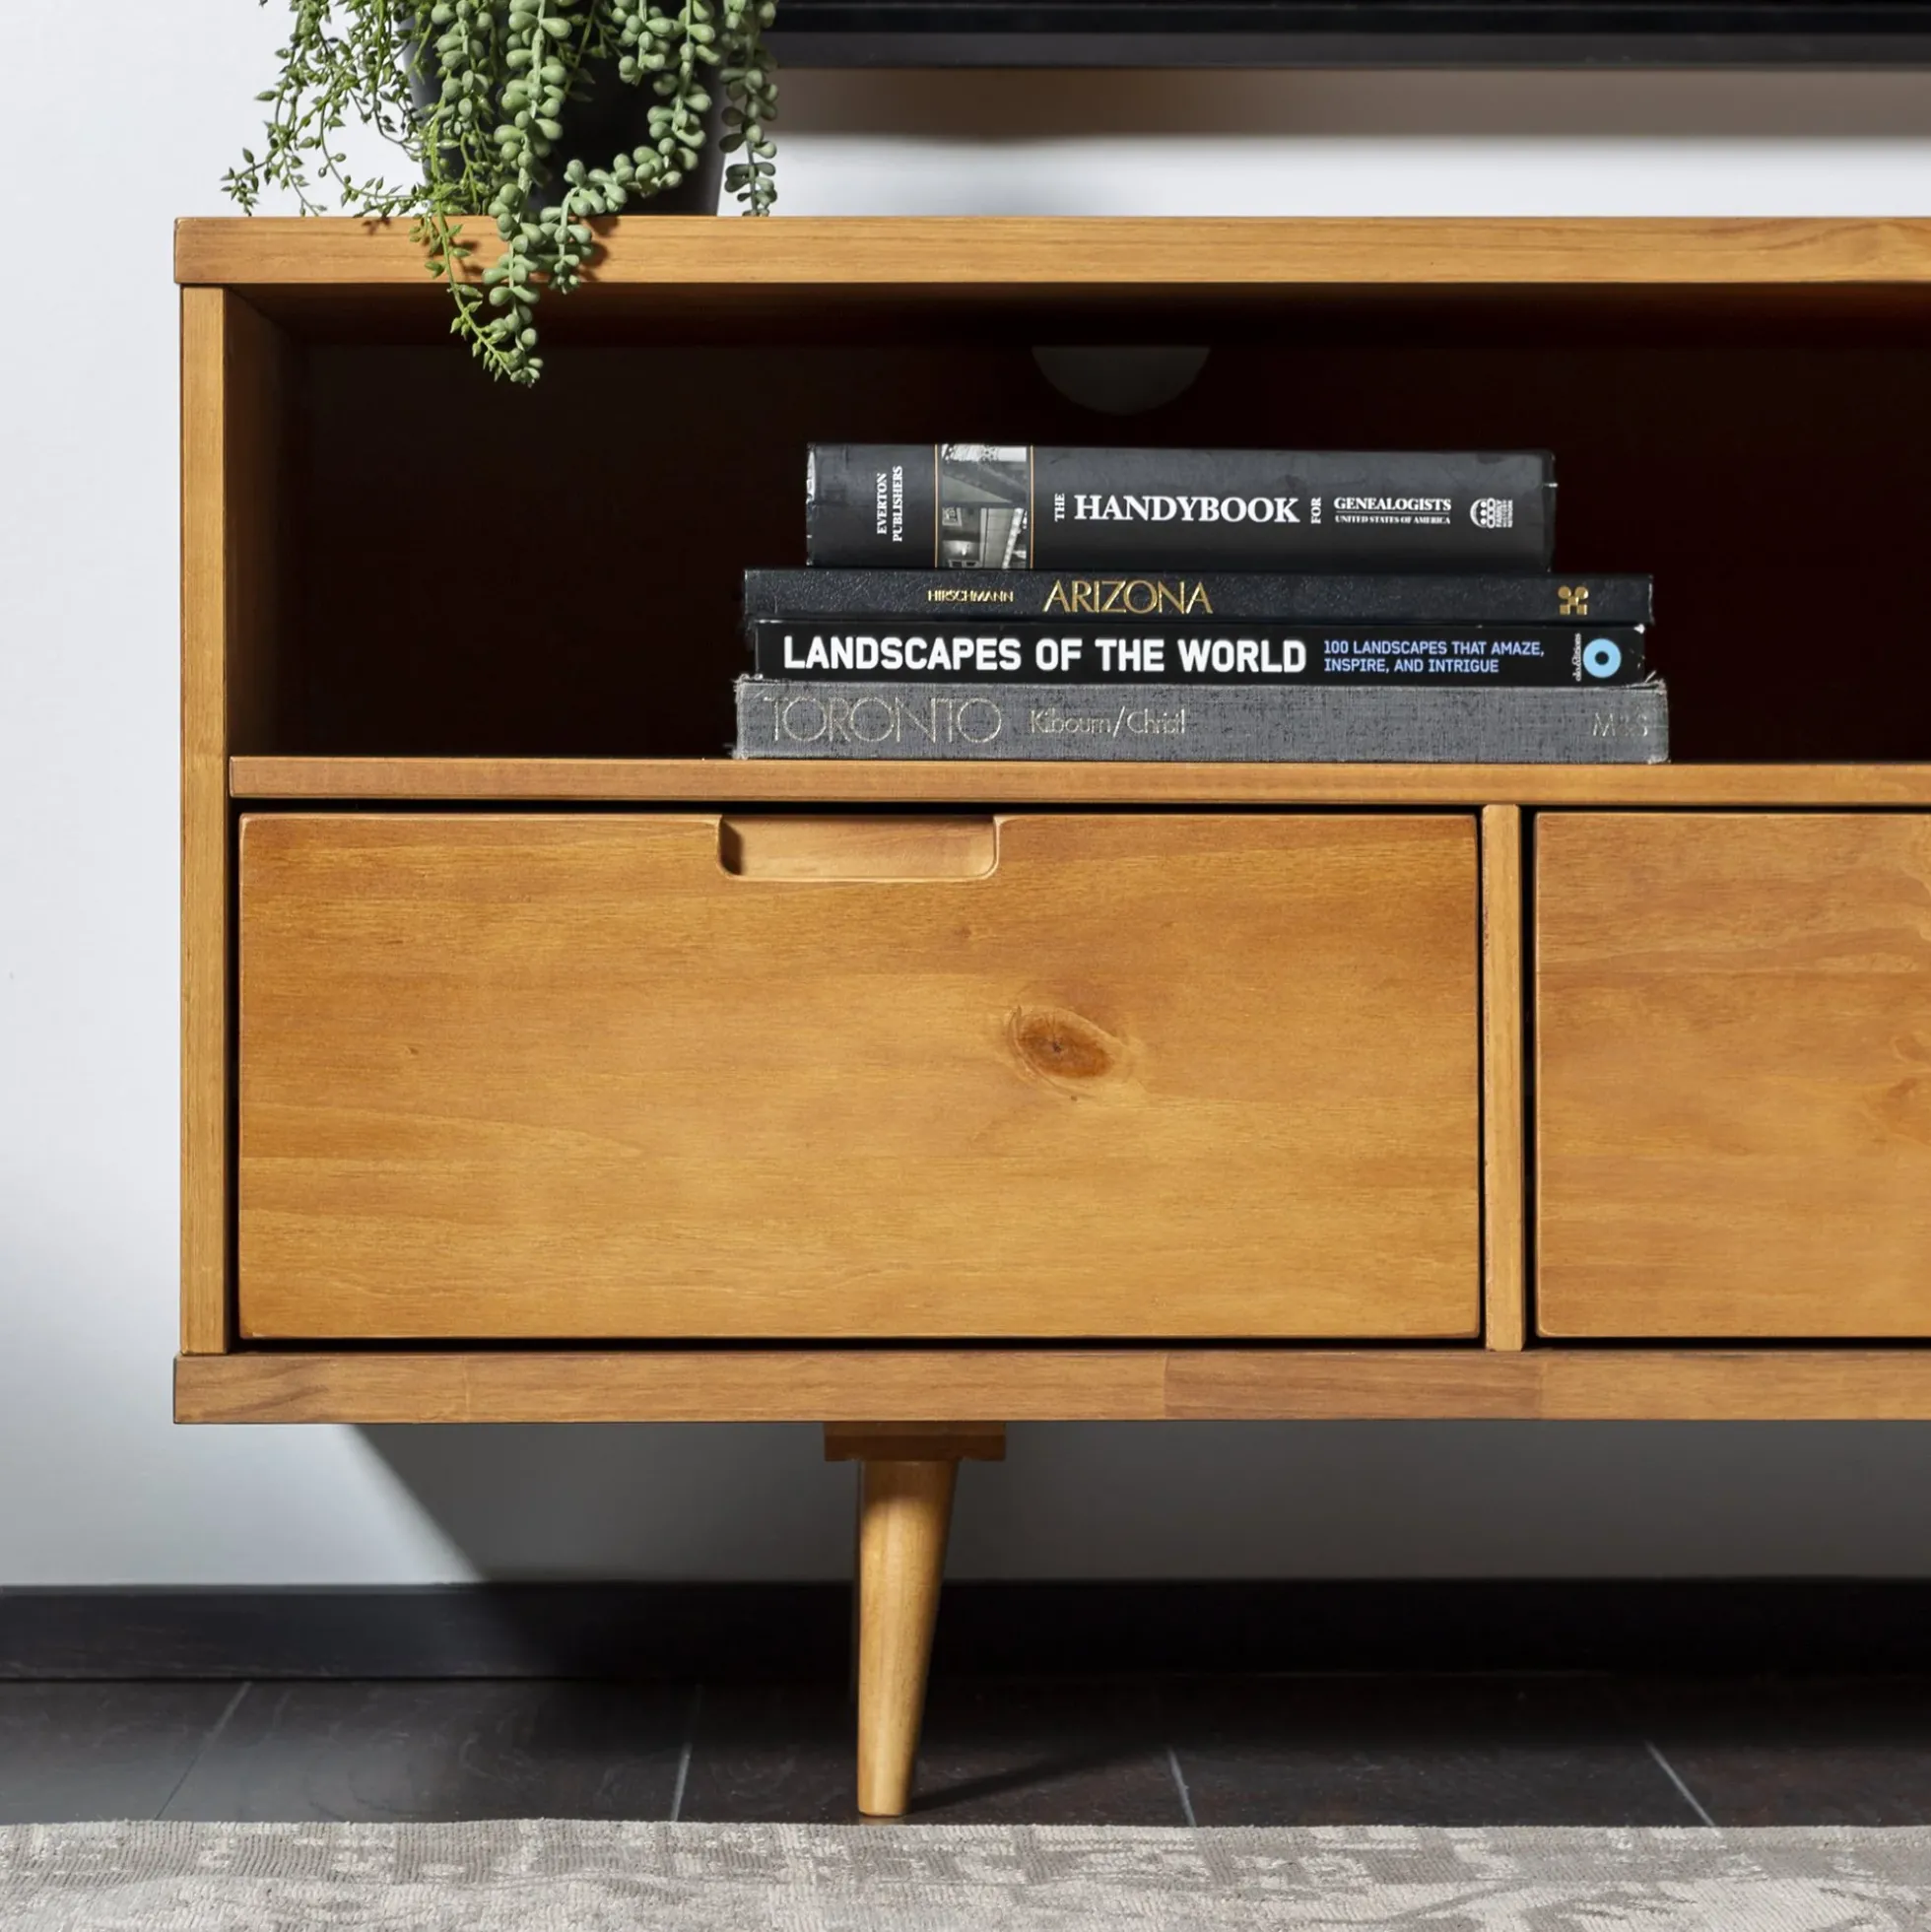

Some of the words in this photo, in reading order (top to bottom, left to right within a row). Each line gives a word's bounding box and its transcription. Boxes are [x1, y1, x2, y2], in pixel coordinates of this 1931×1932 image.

[876, 473, 888, 535] EVERTON
[892, 465, 903, 542] PUBLISHERS
[1054, 494, 1065, 521] THE
[1074, 495, 1300, 522] HANDYBOOK
[1310, 497, 1321, 524] FOR
[1333, 497, 1452, 511] GENEALOGISTS
[1335, 514, 1368, 523] UNITED
[1369, 515, 1399, 524] STATES
[1400, 515, 1412, 524] OF
[1413, 516, 1451, 525] AMERICA
[927, 590, 1014, 603] HIRSCHMANN
[1042, 579, 1214, 615] ARIZONA
[783, 635, 1022, 671] LANDSCAPES
[1035, 637, 1083, 671] OF
[1095, 638, 1165, 672] THE
[1177, 639, 1307, 674] WORLD
[1323, 640, 1350, 654] 100
[1353, 640, 1448, 655] LANDSCAPES
[1451, 640, 1488, 655] THAT
[1491, 641, 1545, 658] AMAZE,
[1324, 658, 1390, 674] INSPIRE,
[1394, 658, 1425, 672] AND
[1428, 658, 1500, 673] INTRIGUE
[764, 697, 1002, 744] TORONTO
